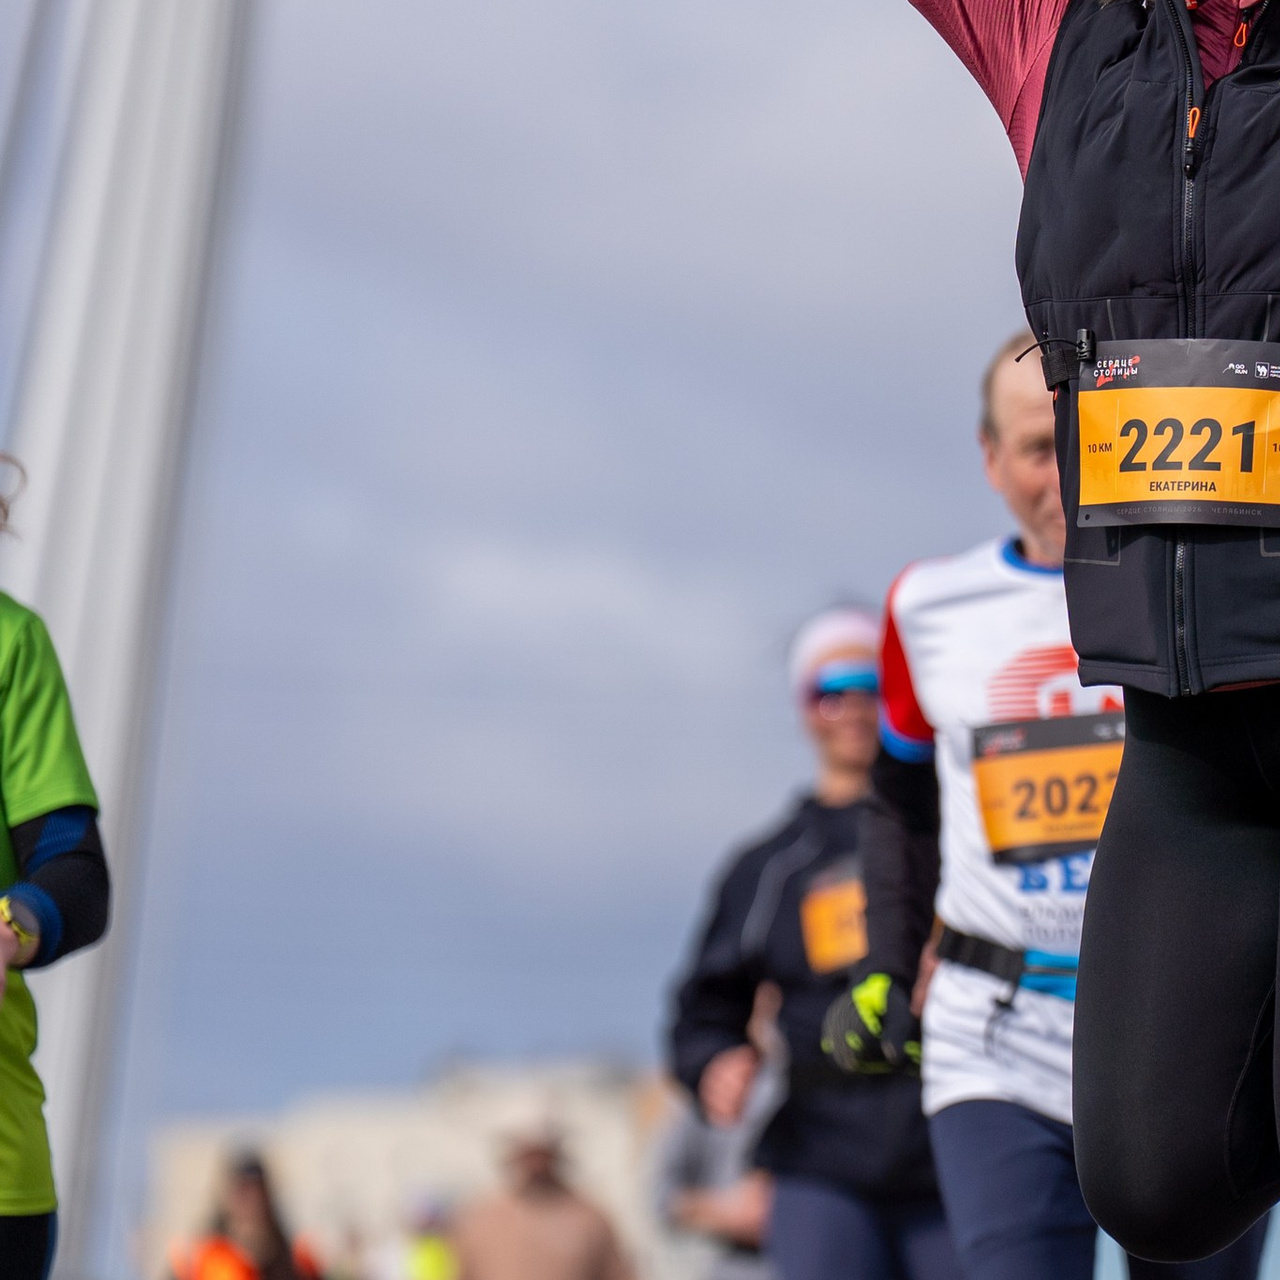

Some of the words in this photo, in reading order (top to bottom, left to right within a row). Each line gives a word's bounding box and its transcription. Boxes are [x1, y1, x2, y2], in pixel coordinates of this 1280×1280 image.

[1097, 359, 1133, 368] СЕРДЦЕ
[1093, 367, 1138, 377] СТОЛИЦЫ
[1088, 443, 1097, 453] 10
[1119, 418, 1255, 472] 2221
[1149, 481, 1217, 492] ЕКАТЕРИНА
